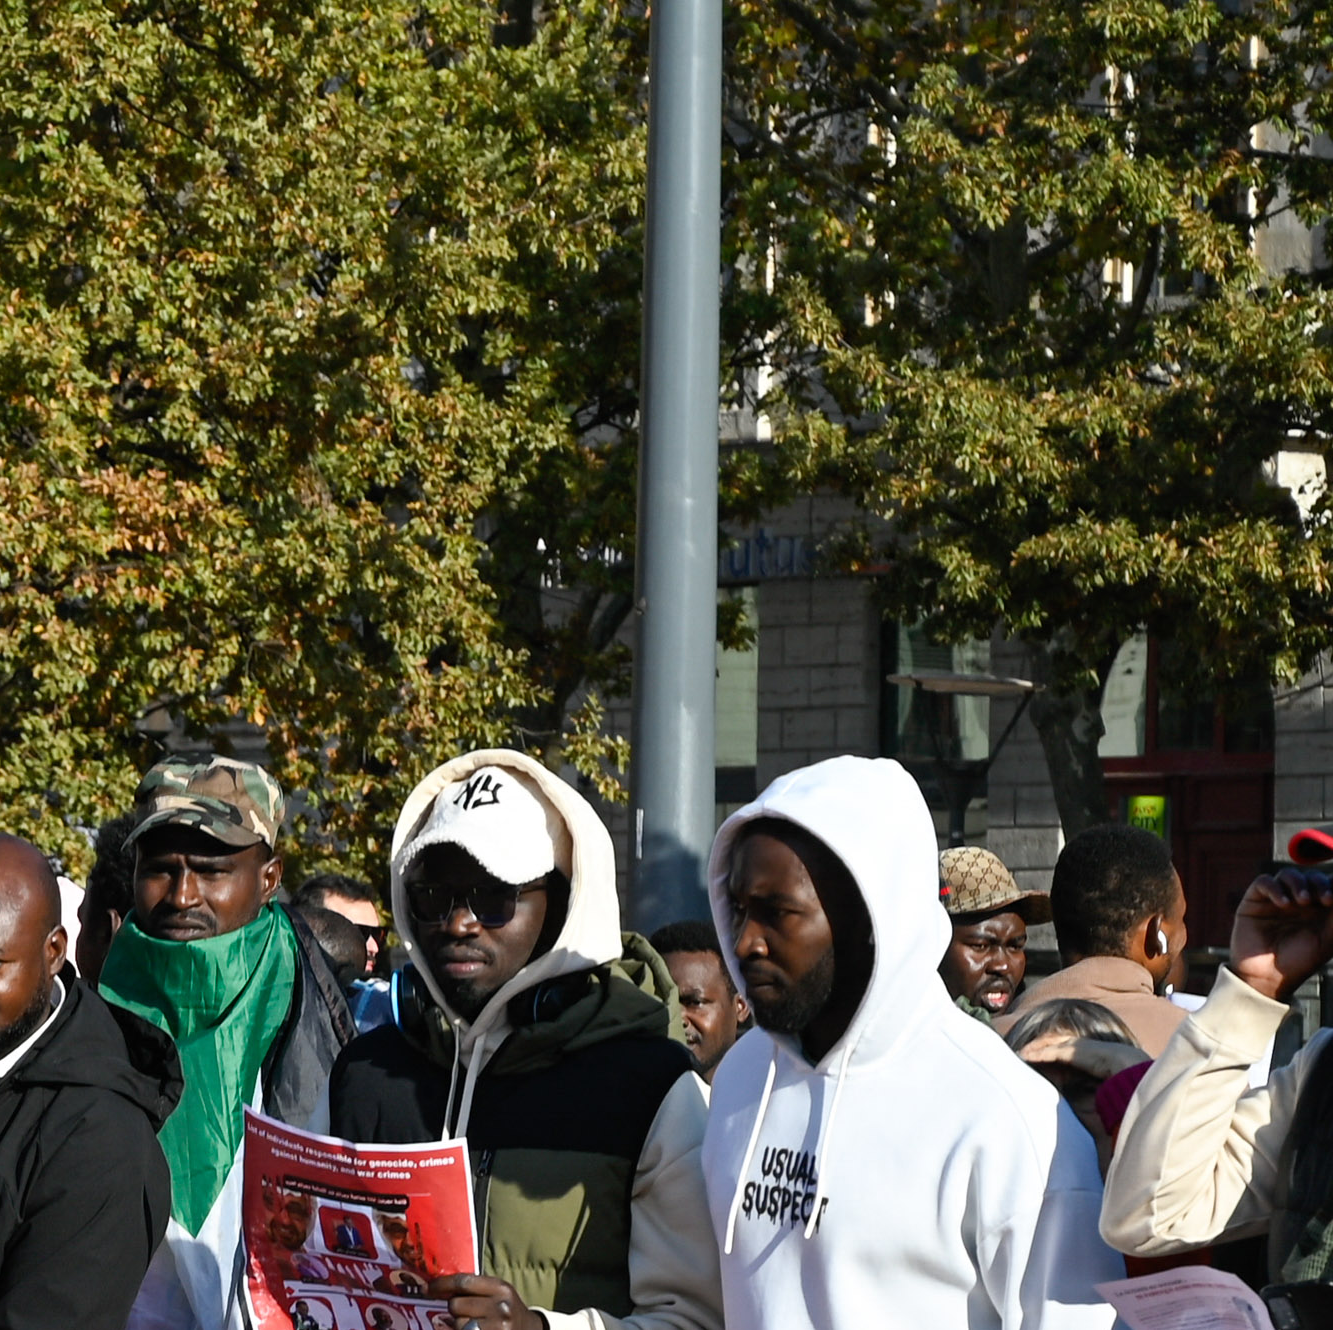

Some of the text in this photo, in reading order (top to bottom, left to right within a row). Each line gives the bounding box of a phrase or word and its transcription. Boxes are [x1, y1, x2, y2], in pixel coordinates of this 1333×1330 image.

[453, 773, 504, 811] NY
[247, 1121, 258, 1135] List
[258, 1129, 266, 1137] of
[305, 1147, 353, 1165] responsible
[353, 1157, 367, 1166] for
[369, 1158, 418, 1169] genocide,
[419, 1156, 455, 1168] crimes
[271, 1146, 411, 1180] against humanity, and war crimes
[761, 1146, 818, 1188] USUAL
[742, 1181, 830, 1234] SUSPECT
